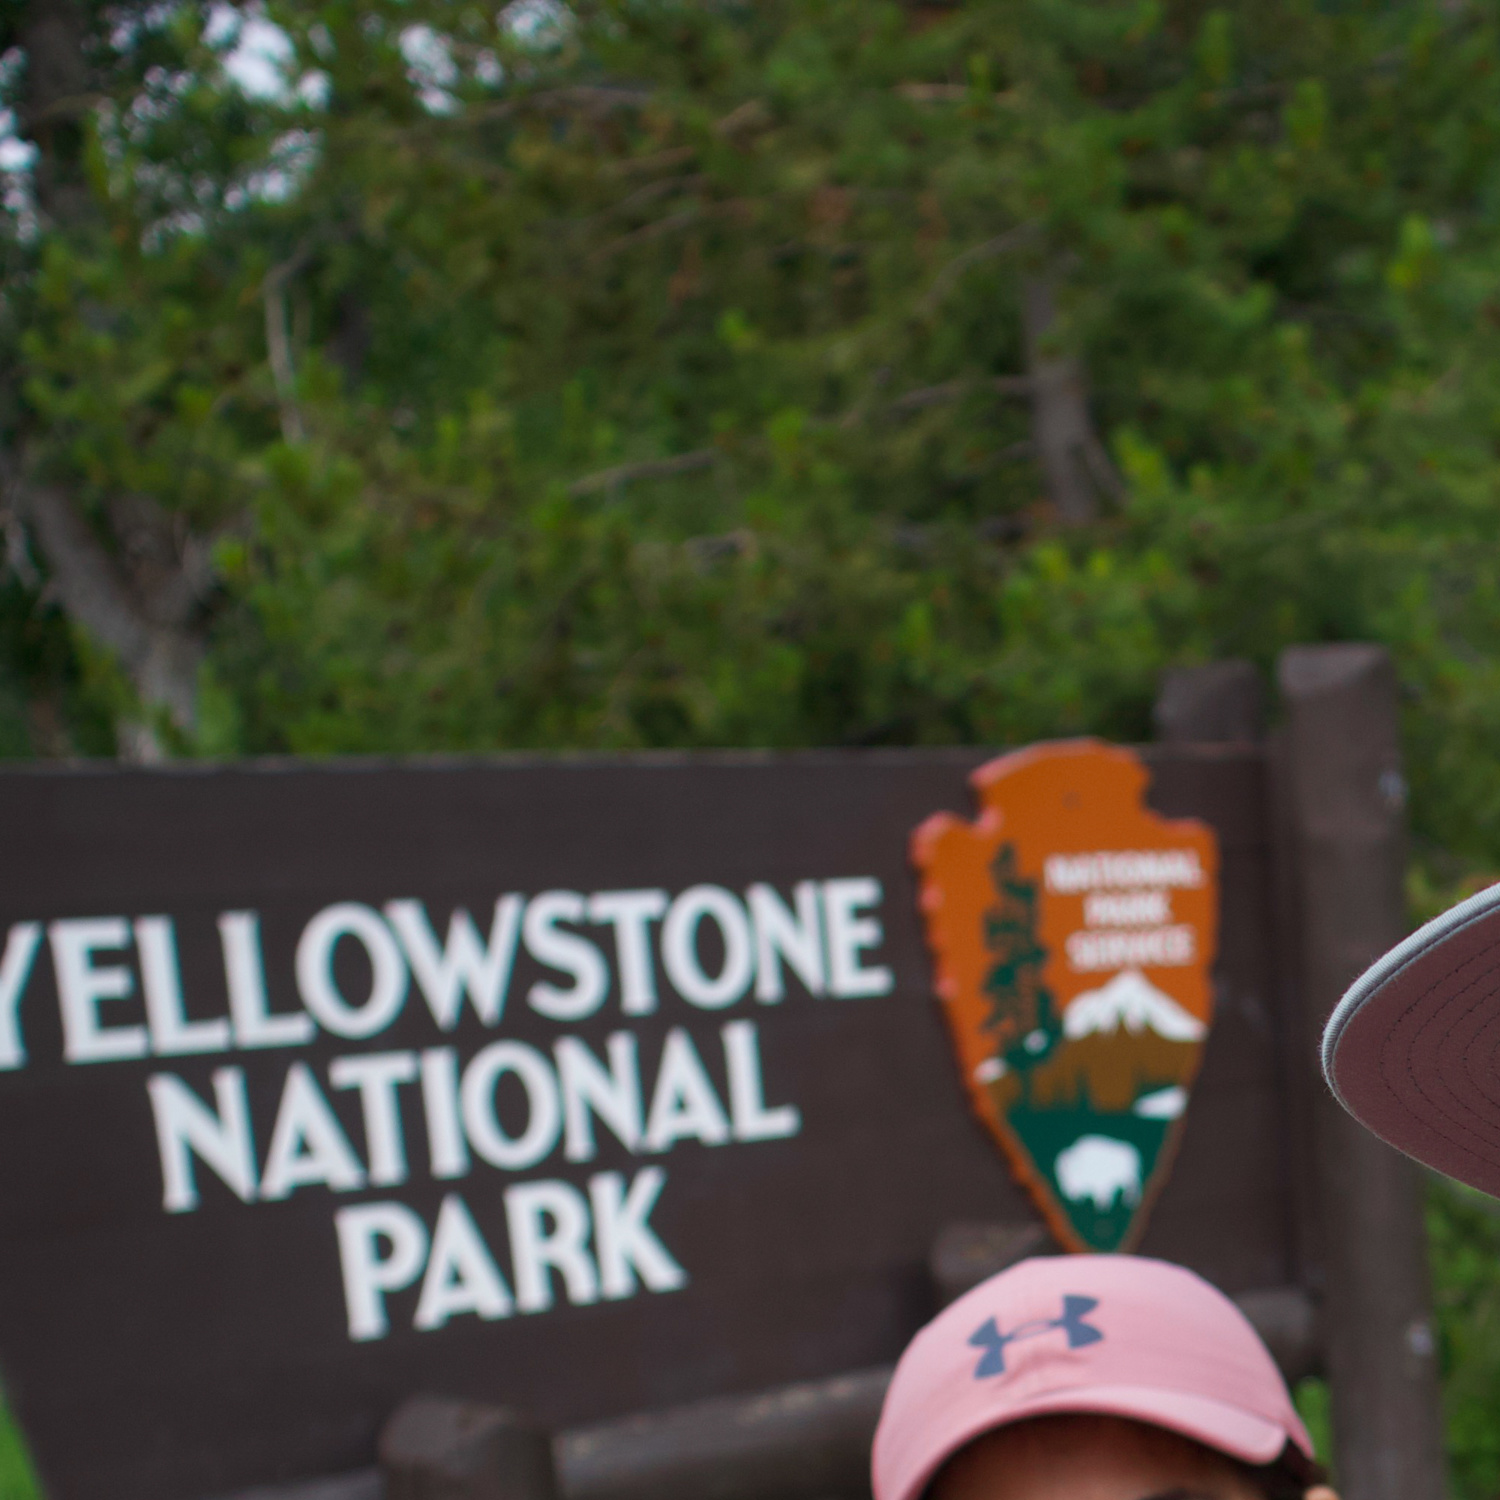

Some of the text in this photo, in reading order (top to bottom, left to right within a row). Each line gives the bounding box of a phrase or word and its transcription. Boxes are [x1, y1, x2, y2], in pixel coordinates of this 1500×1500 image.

[1044, 850, 1205, 891] NATIONAL
[1083, 889, 1171, 927] PARK
[0, 877, 893, 1070] YELLOWSTONE
[1066, 925, 1196, 971] SERVICE
[147, 1020, 800, 1212] NATIONAL
[334, 1166, 690, 1340] PARK
